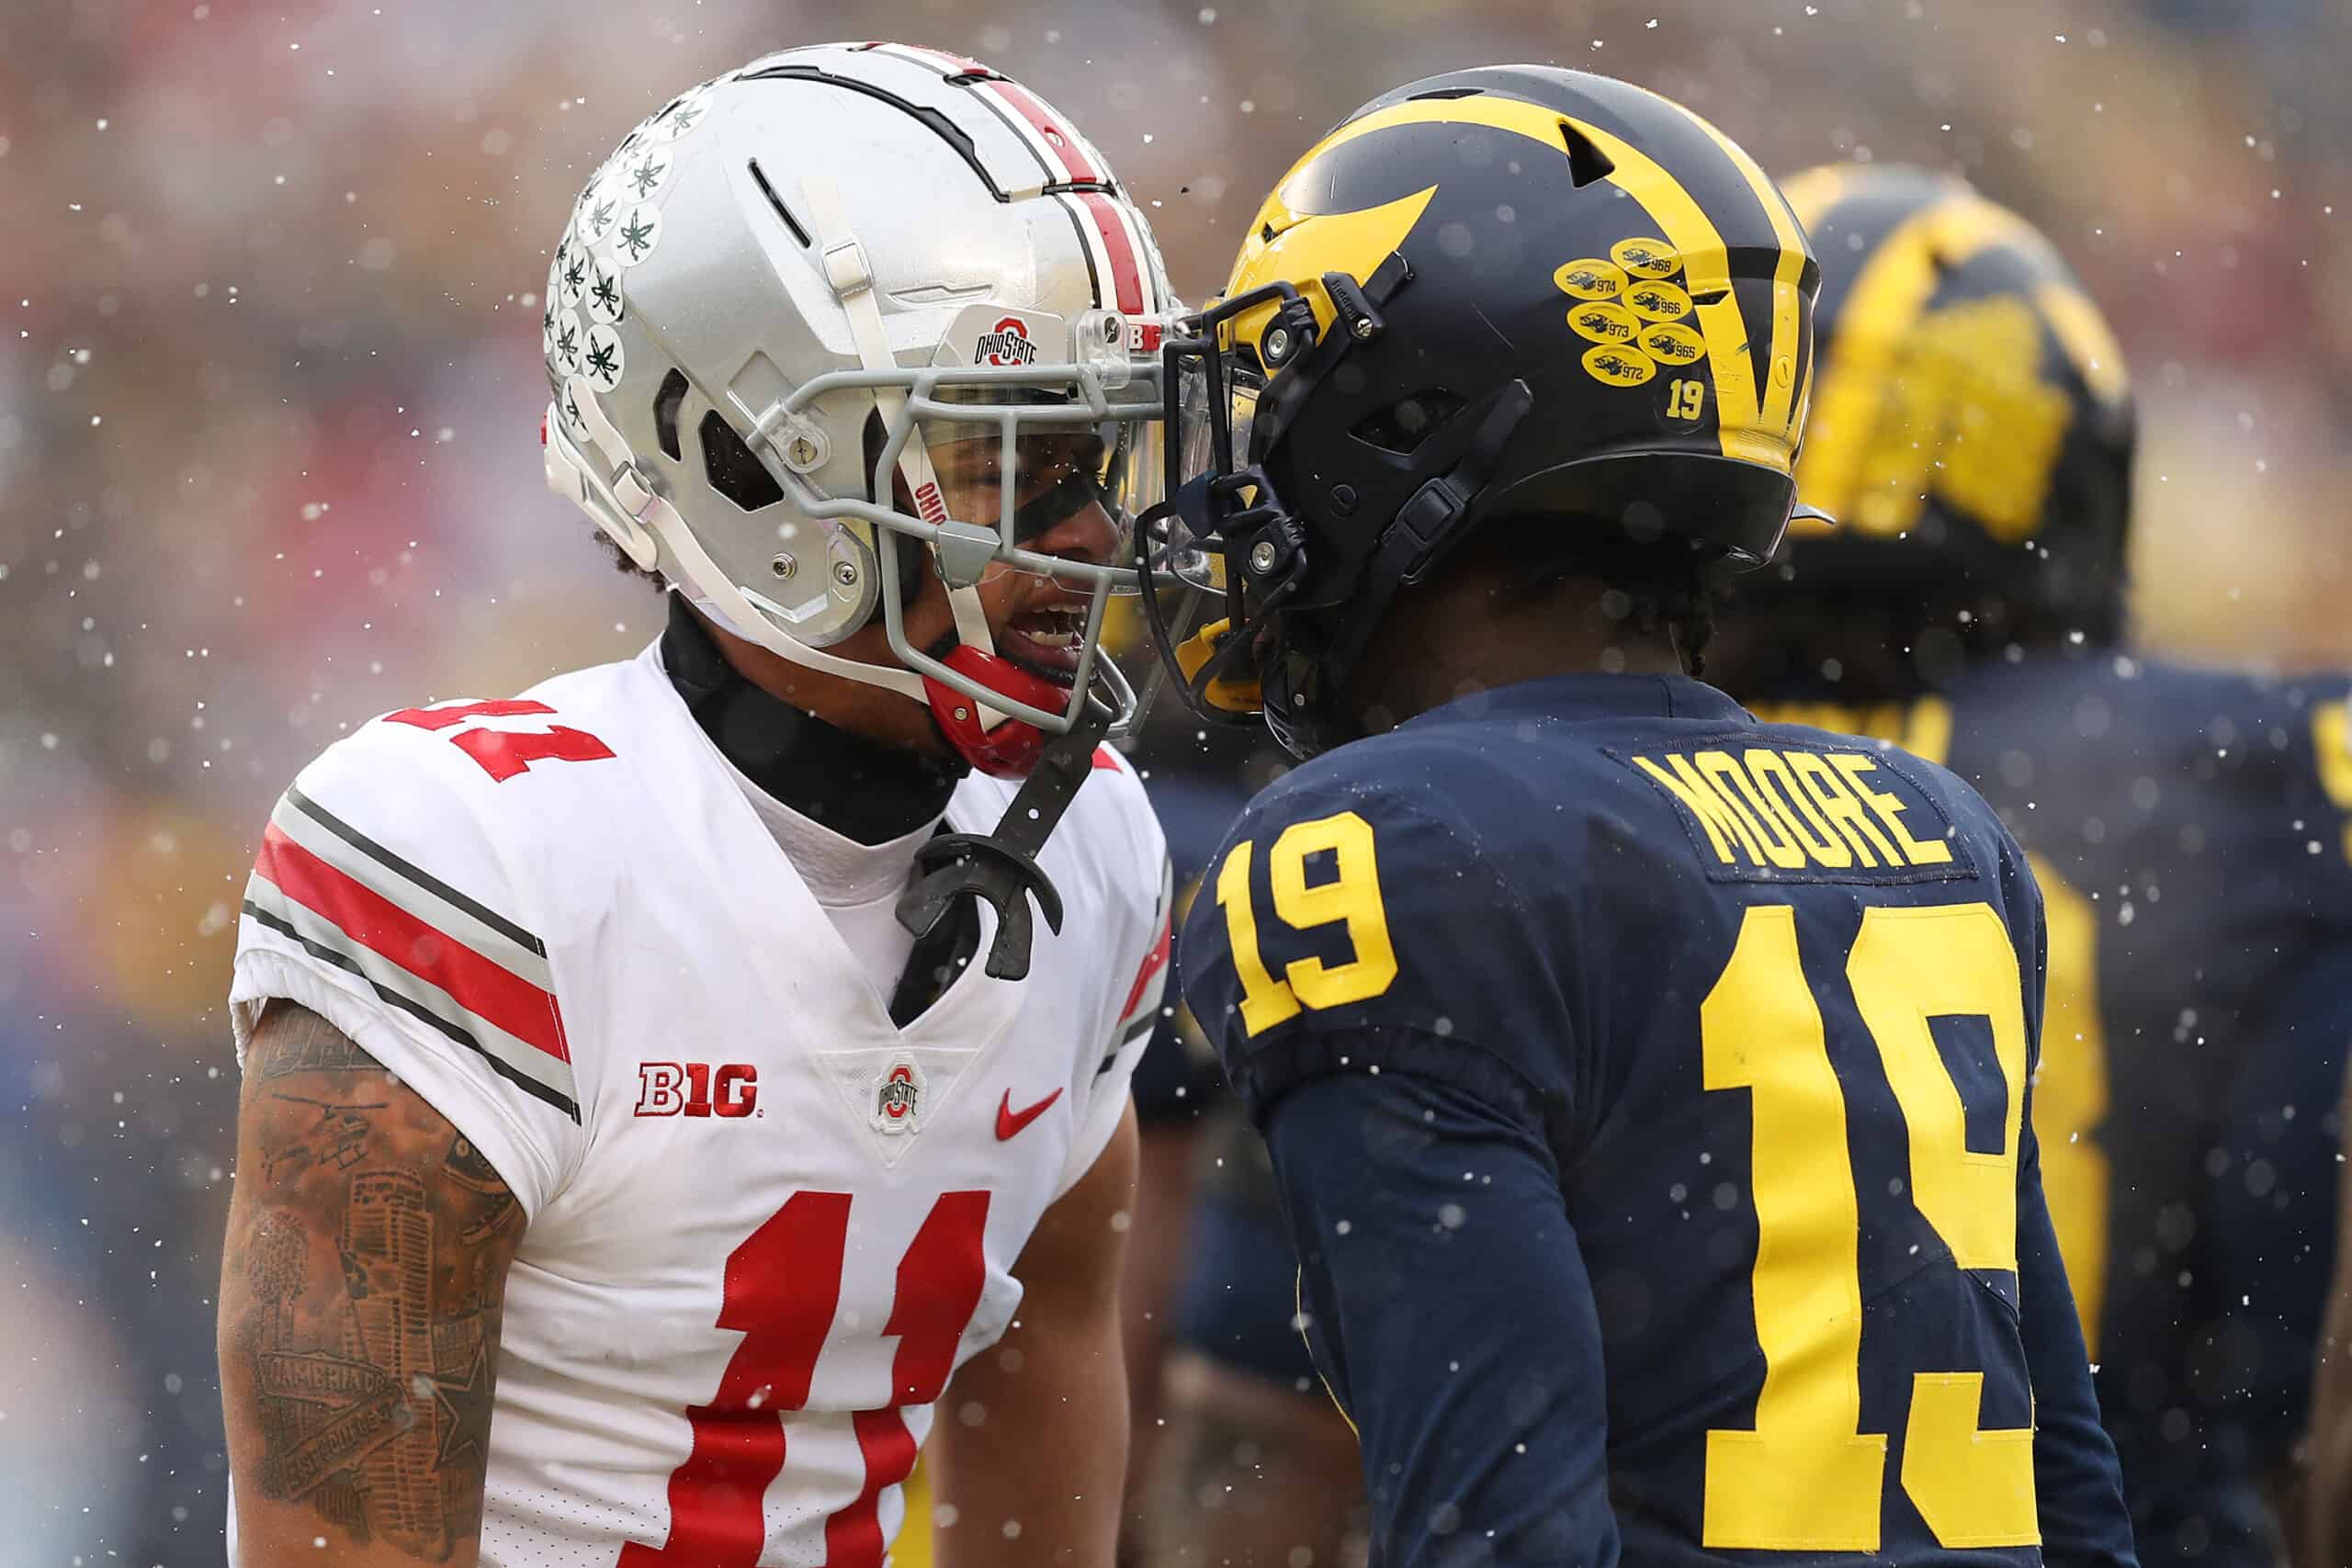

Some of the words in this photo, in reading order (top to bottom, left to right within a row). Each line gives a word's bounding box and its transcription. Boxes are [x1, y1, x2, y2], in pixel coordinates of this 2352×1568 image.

[1650, 258, 1672, 274] 968
[1597, 279, 1617, 294] 974
[1660, 300, 1681, 315] 966
[1609, 323, 1630, 338] 973
[975, 333, 1003, 365] OHIO
[1676, 344, 1696, 359] 965
[1623, 366, 1644, 380] 972
[1666, 378, 1705, 421] 19
[1632, 749, 1954, 870] MOORE
[1216, 810, 1399, 1040] 19
[1700, 902, 2043, 1552] 19
[616, 1190, 992, 1568] 11
